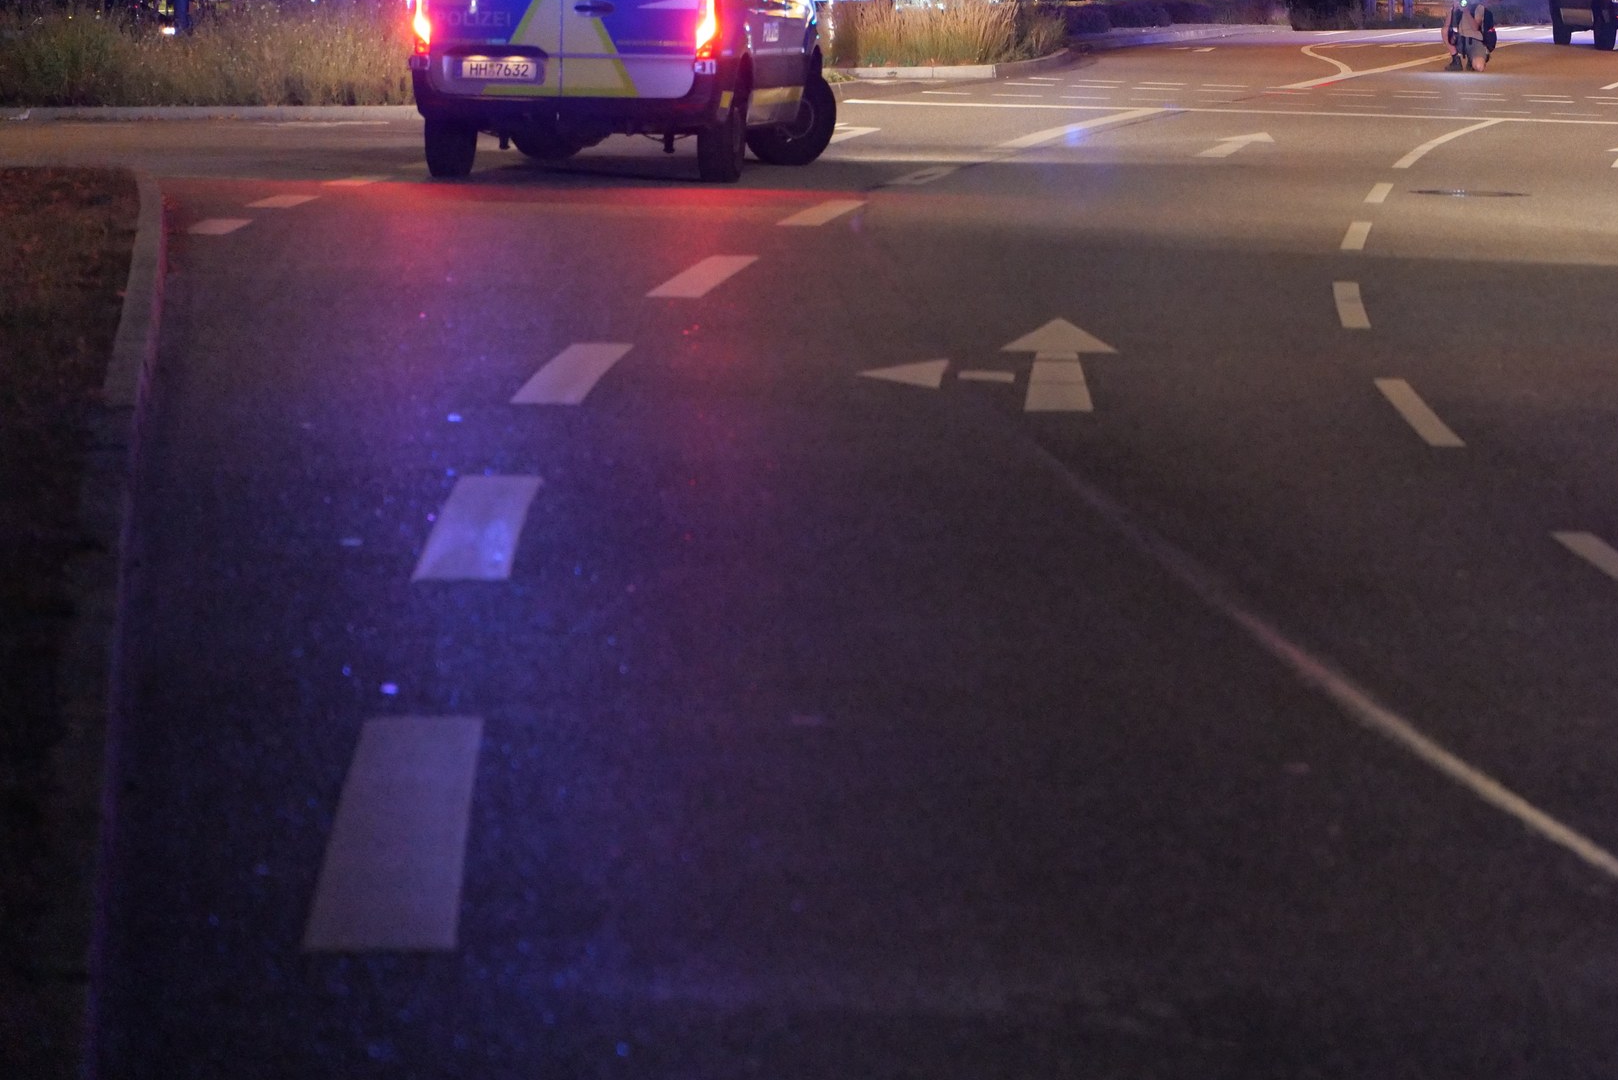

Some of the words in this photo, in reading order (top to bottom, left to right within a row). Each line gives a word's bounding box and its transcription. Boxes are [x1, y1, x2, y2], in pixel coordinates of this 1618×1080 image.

[436, 11, 511, 27] POLIZEI
[470, 63, 488, 76] HH
[495, 63, 530, 78] 7632
